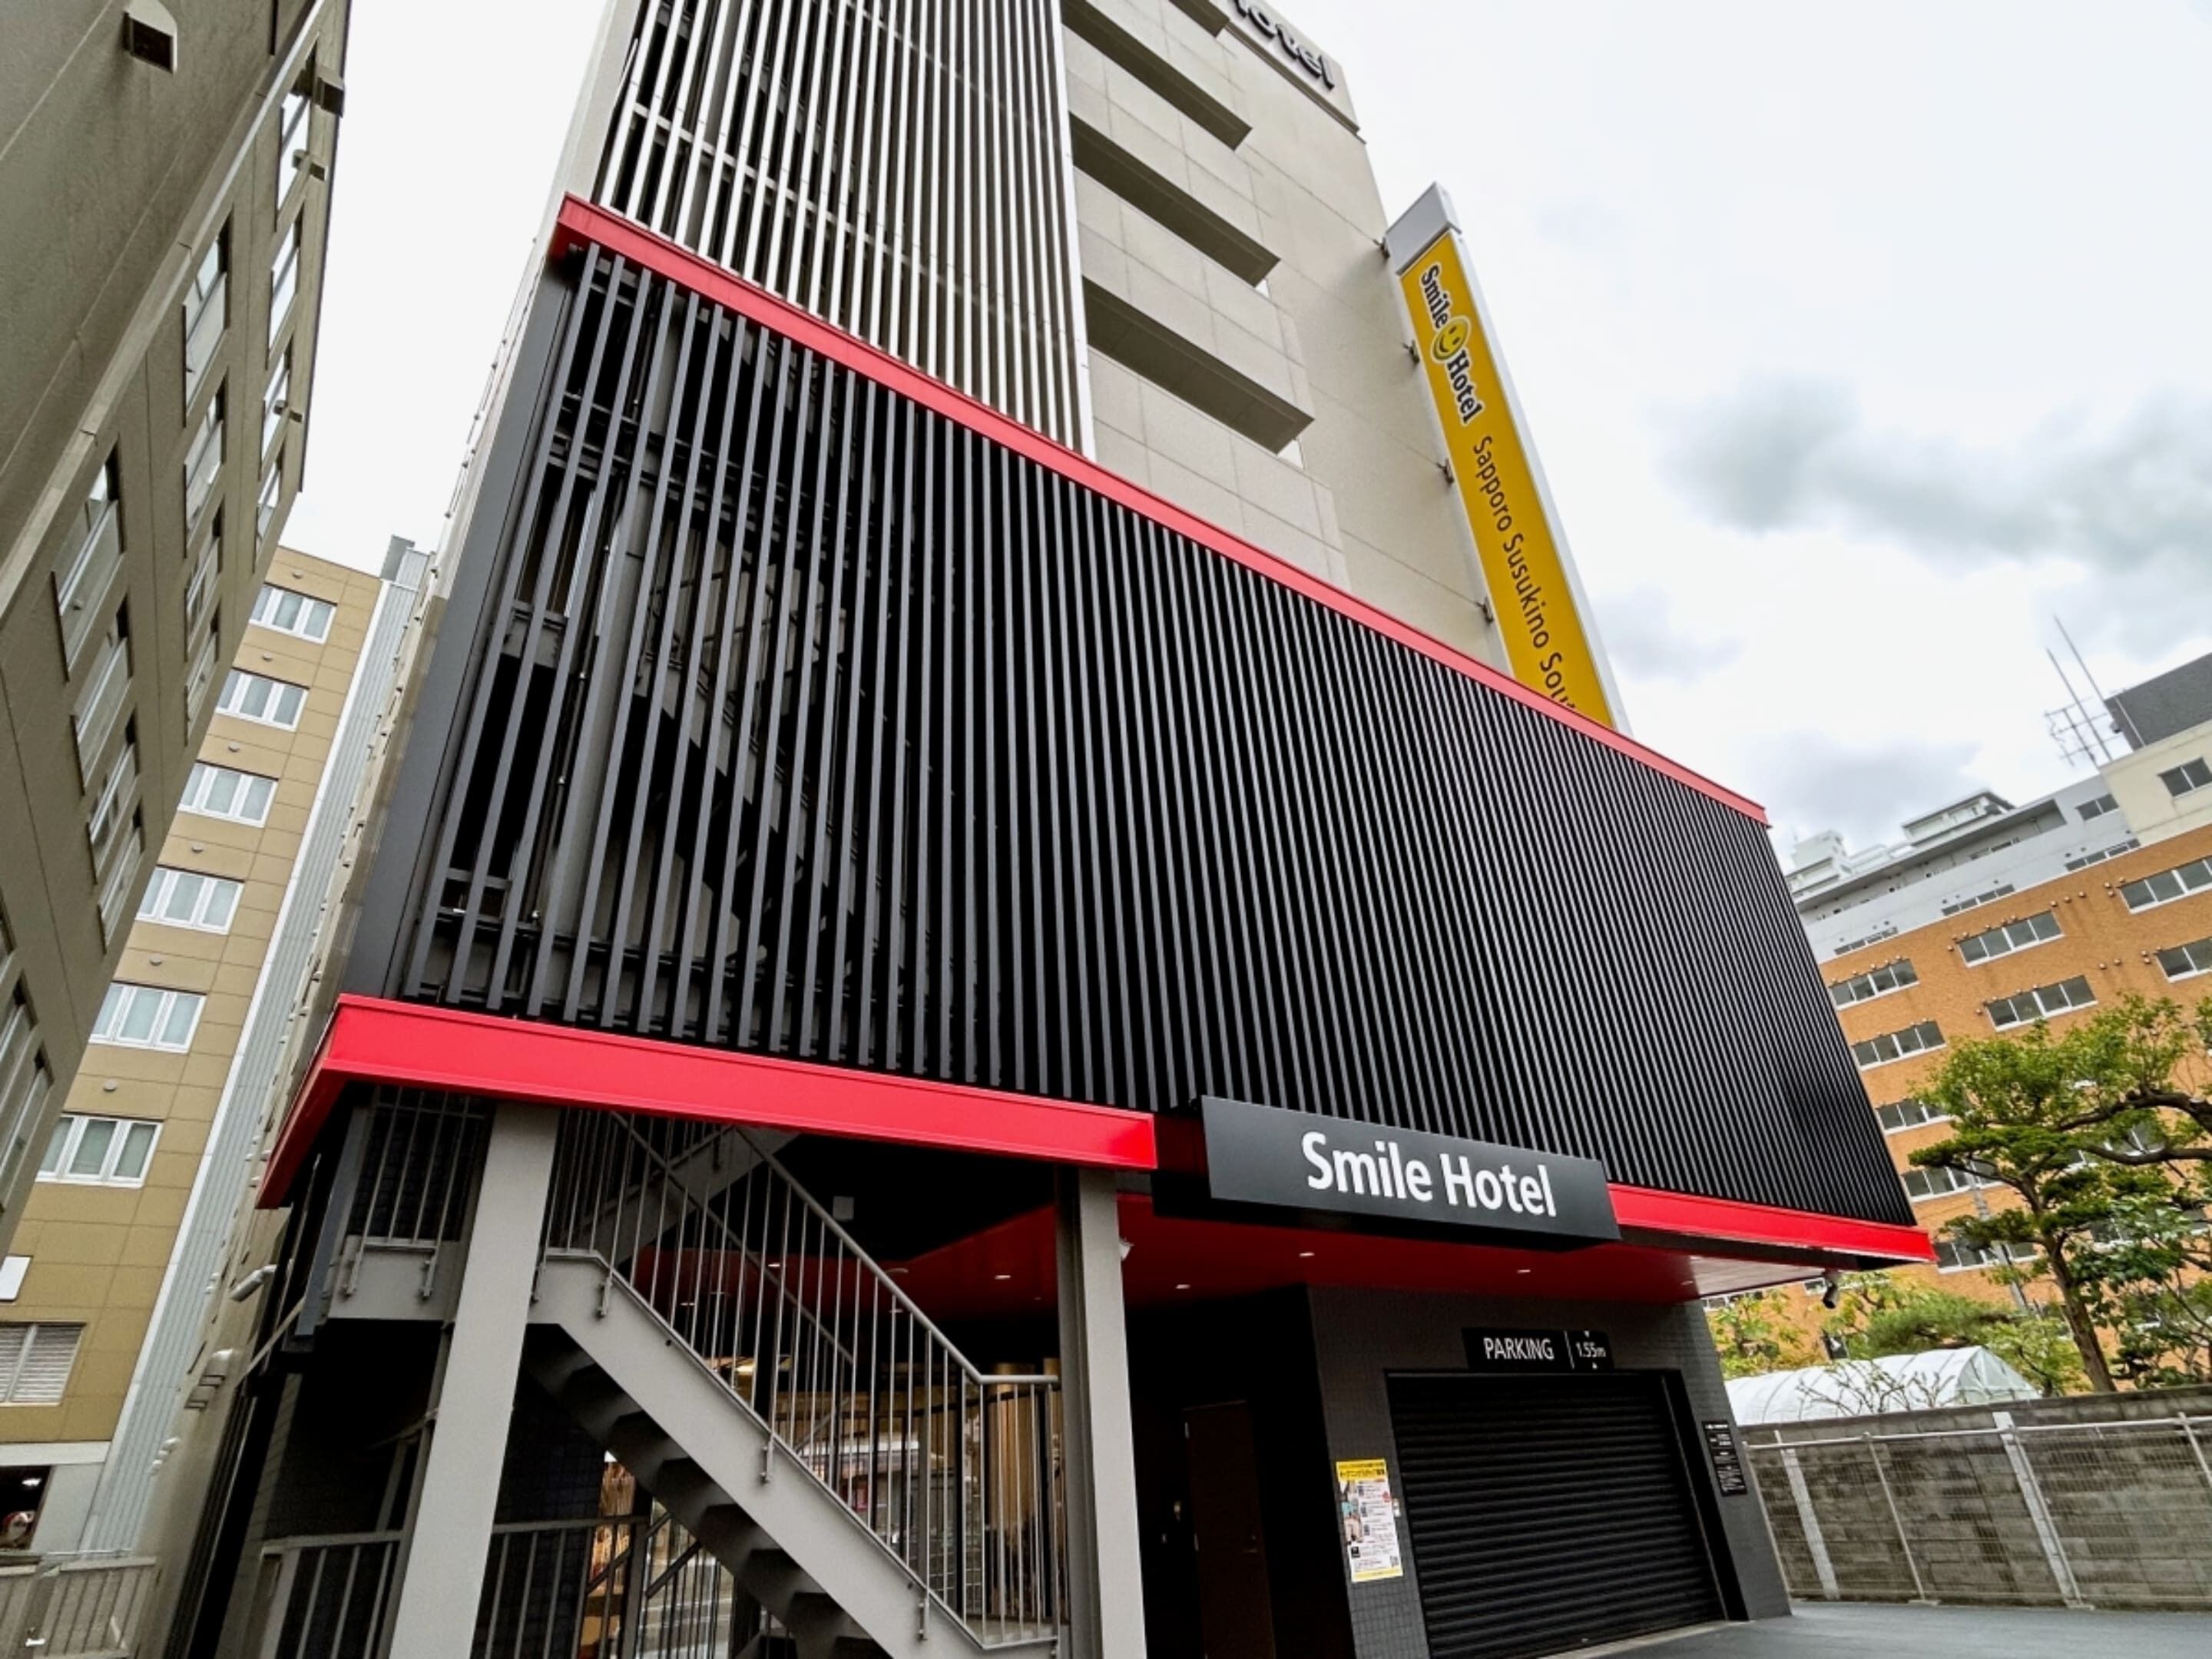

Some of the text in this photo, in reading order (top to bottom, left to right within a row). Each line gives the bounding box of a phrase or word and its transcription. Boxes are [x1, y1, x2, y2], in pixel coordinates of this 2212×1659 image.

[1421, 264, 1483, 424] Smile Hotel
[1473, 435, 1512, 531] Sapporo
[1503, 533, 1549, 649] Susukino
[1301, 1131, 1556, 1217] Smile Hotel
[1483, 1337, 1555, 1360] PARKING
